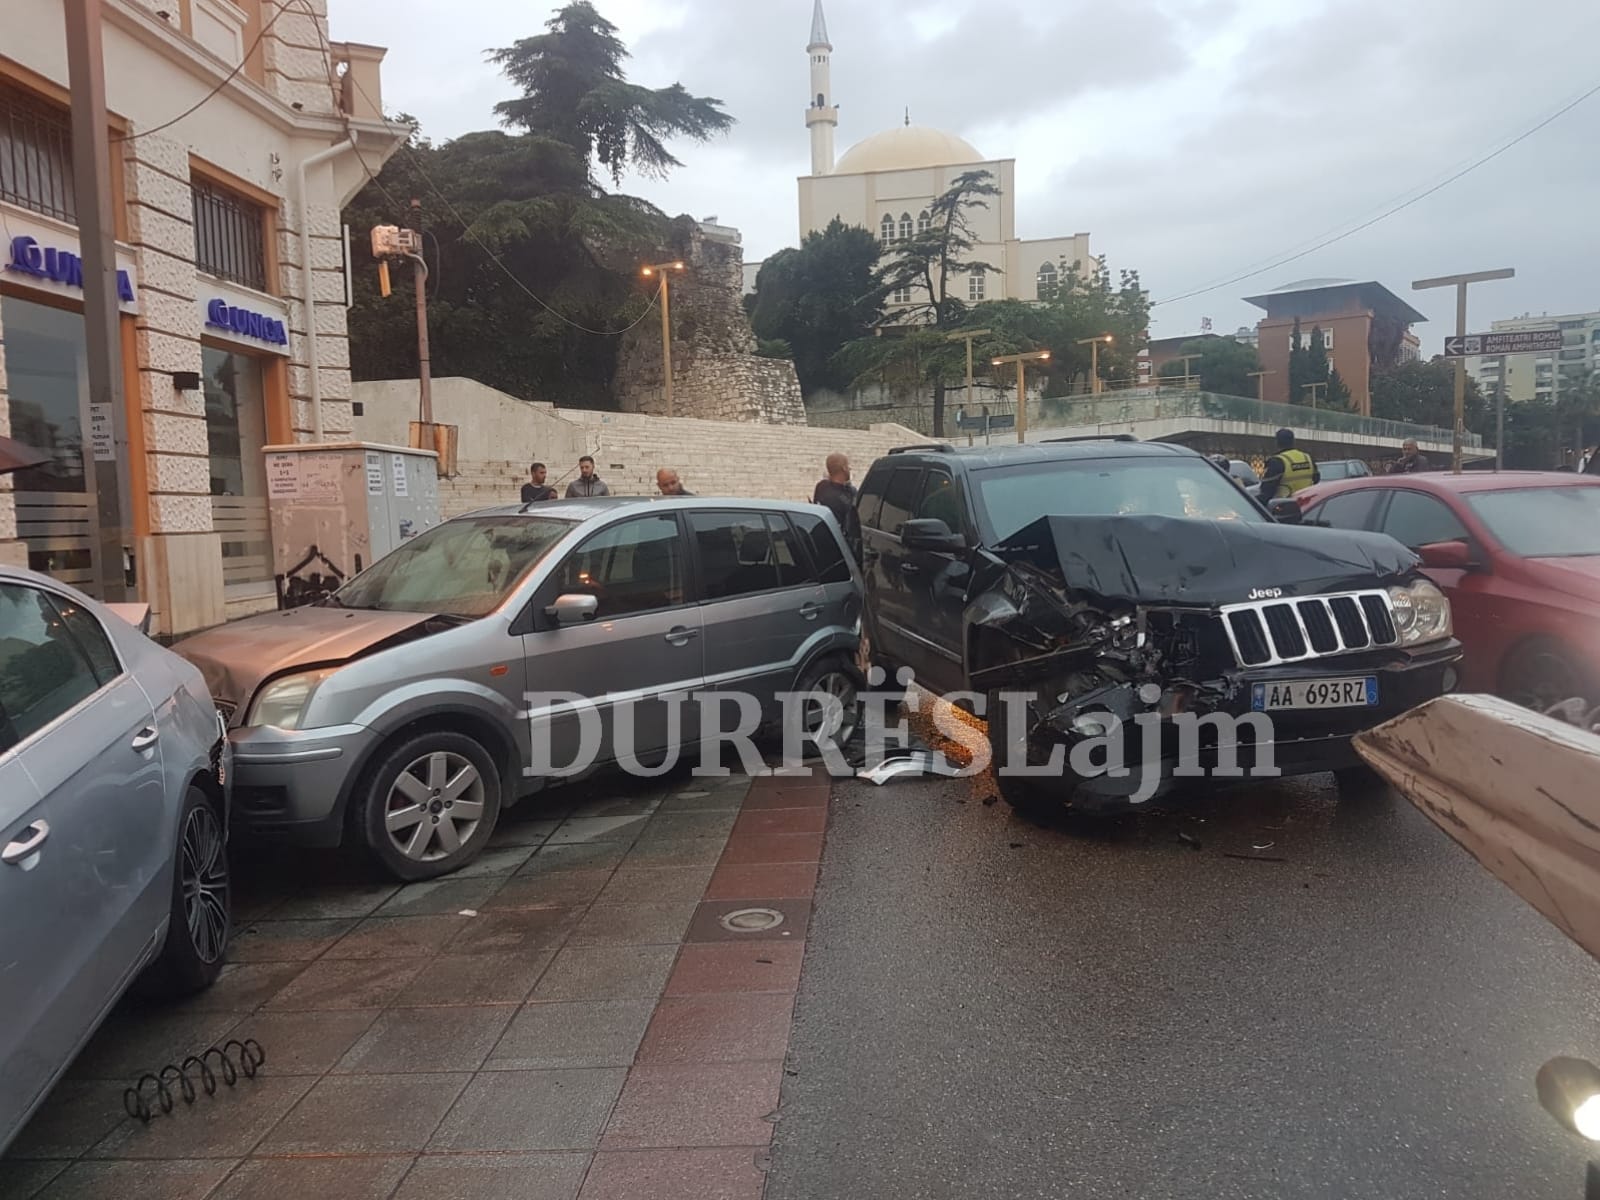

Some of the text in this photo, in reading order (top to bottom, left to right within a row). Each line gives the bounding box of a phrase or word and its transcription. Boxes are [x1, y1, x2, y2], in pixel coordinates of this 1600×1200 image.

[1486, 334, 1532, 344] AMFITEATRI
[1486, 342, 1511, 353] ROMAN
[1248, 586, 1282, 600] Jeep
[1269, 685, 1294, 707] AA
[1305, 681, 1365, 705] 693RZ
